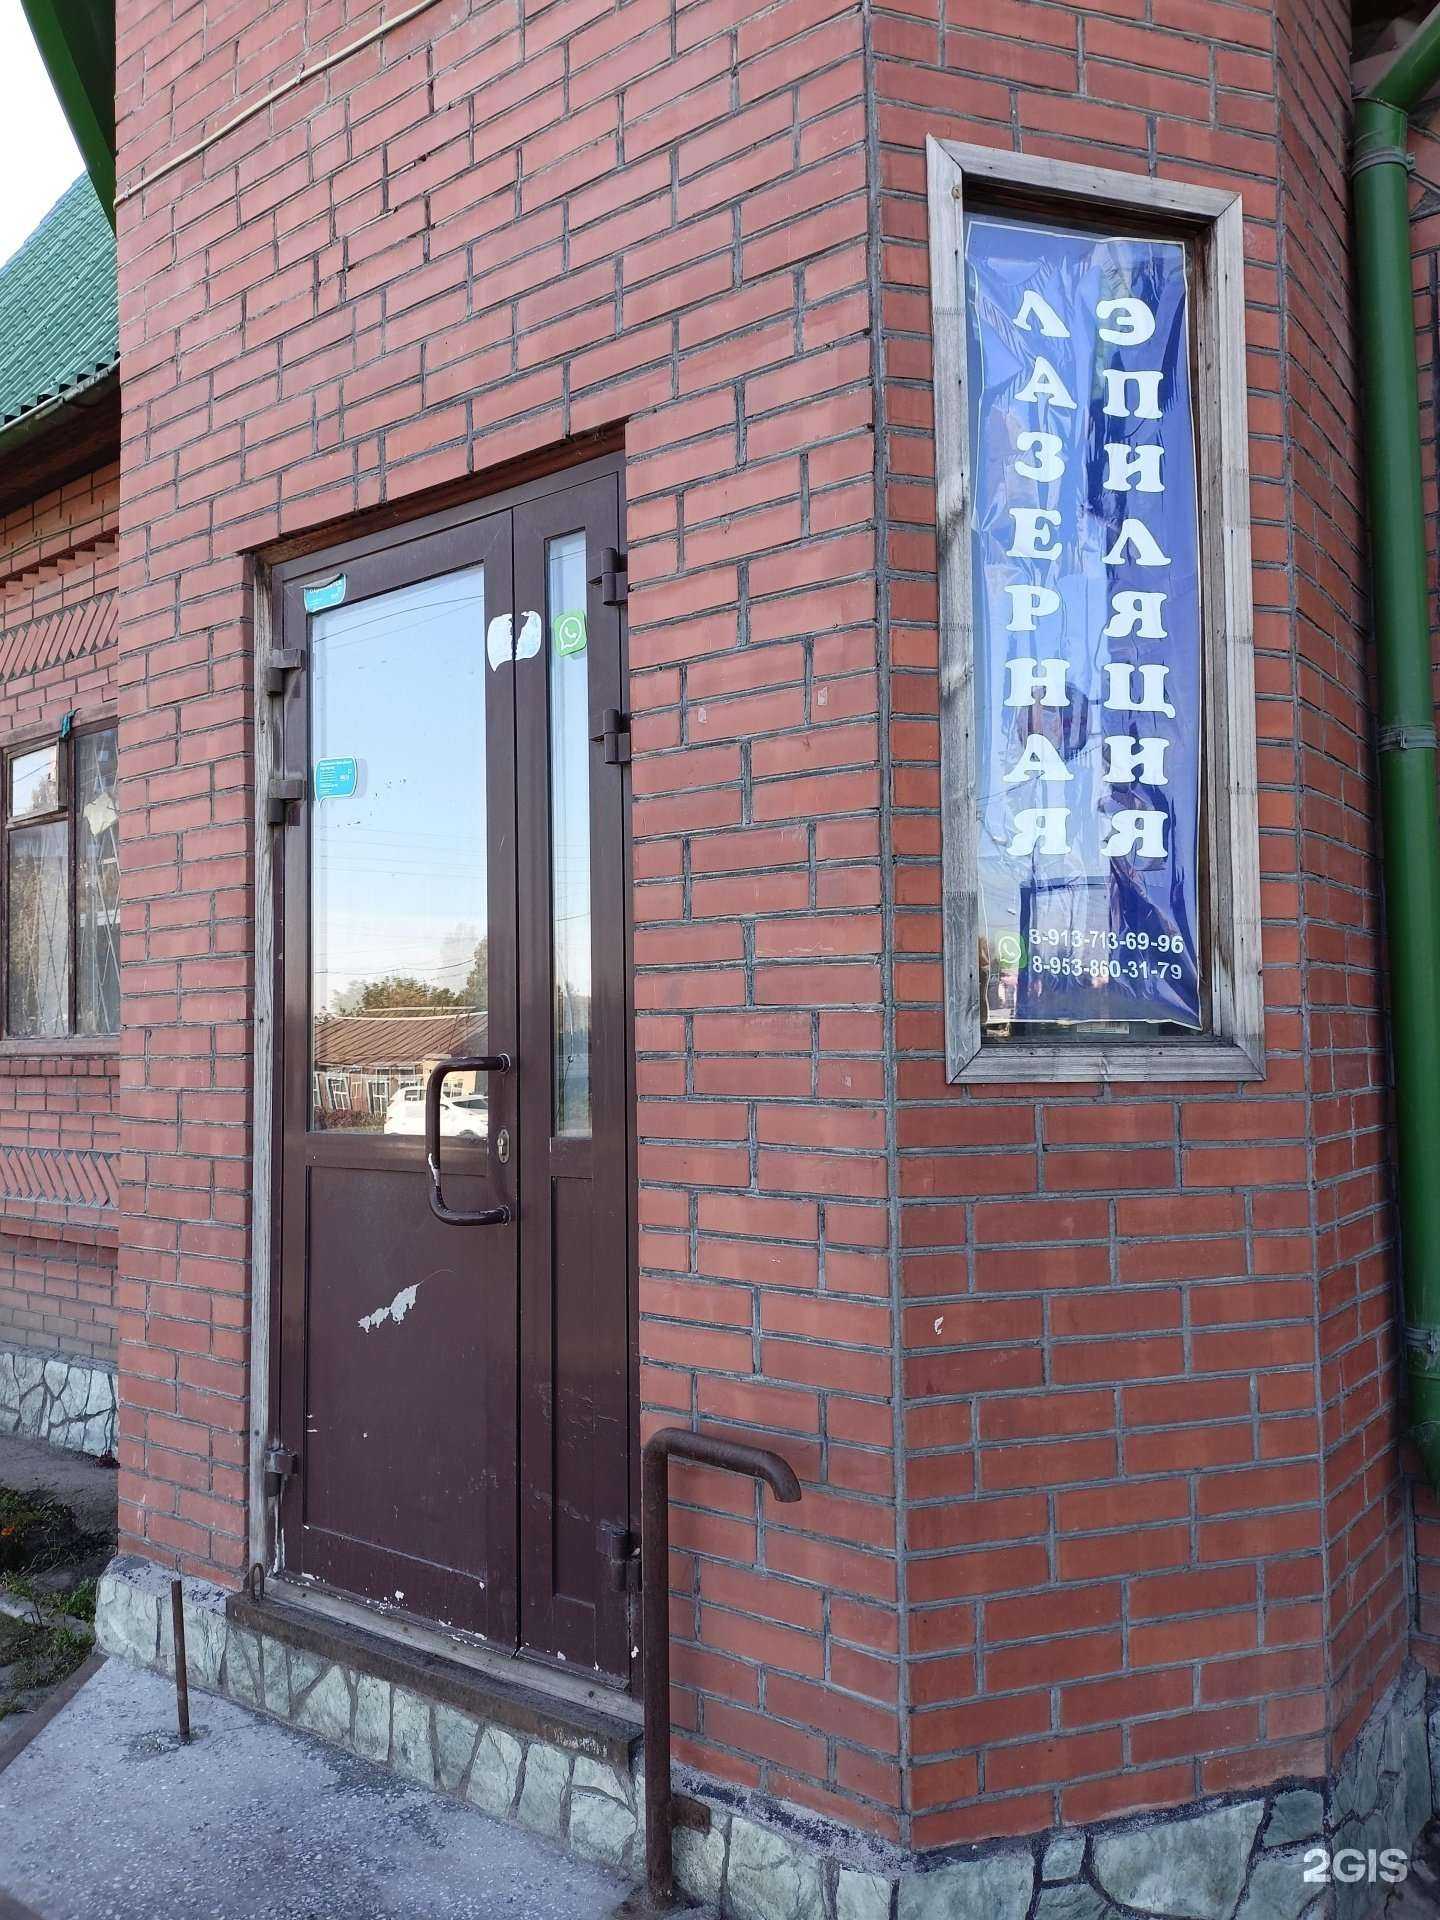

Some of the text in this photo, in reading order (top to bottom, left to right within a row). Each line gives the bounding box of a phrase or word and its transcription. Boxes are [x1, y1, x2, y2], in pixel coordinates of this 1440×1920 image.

[1003, 290, 1077, 856] ЛАЗЕРНАЯ
[1096, 297, 1175, 858] ЭПИЛЯЦИЯ
[1029, 928, 1184, 953] 8-913-713-69-96
[1032, 957, 1182, 980] 8-953-860-31-79
